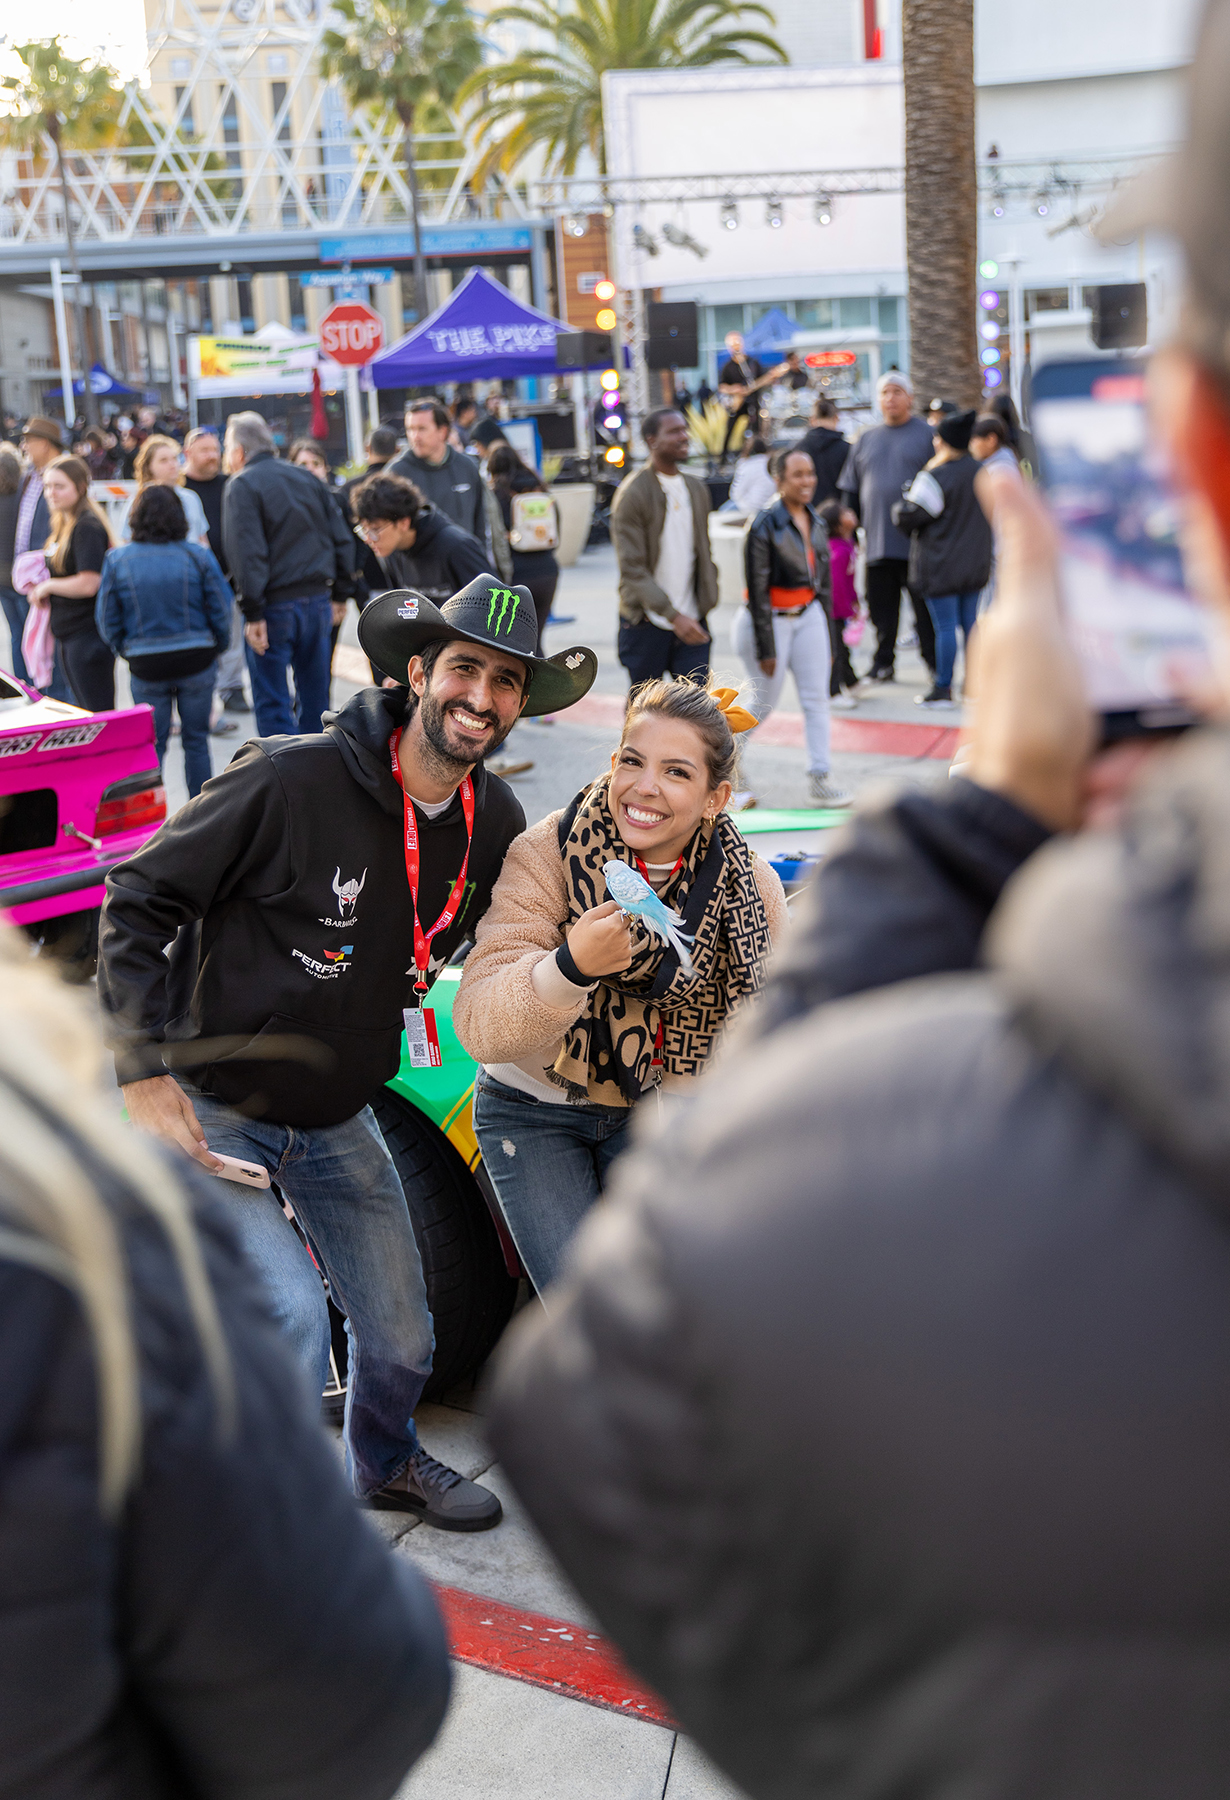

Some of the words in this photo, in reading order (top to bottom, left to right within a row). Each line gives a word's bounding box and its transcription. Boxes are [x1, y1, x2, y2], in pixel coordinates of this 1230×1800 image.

[322, 319, 382, 352] STOP
[424, 325, 487, 353] THE
[487, 323, 556, 347] PIKE
[407, 807, 415, 831] FORMULA
[407, 830, 417, 850] DRIFT
